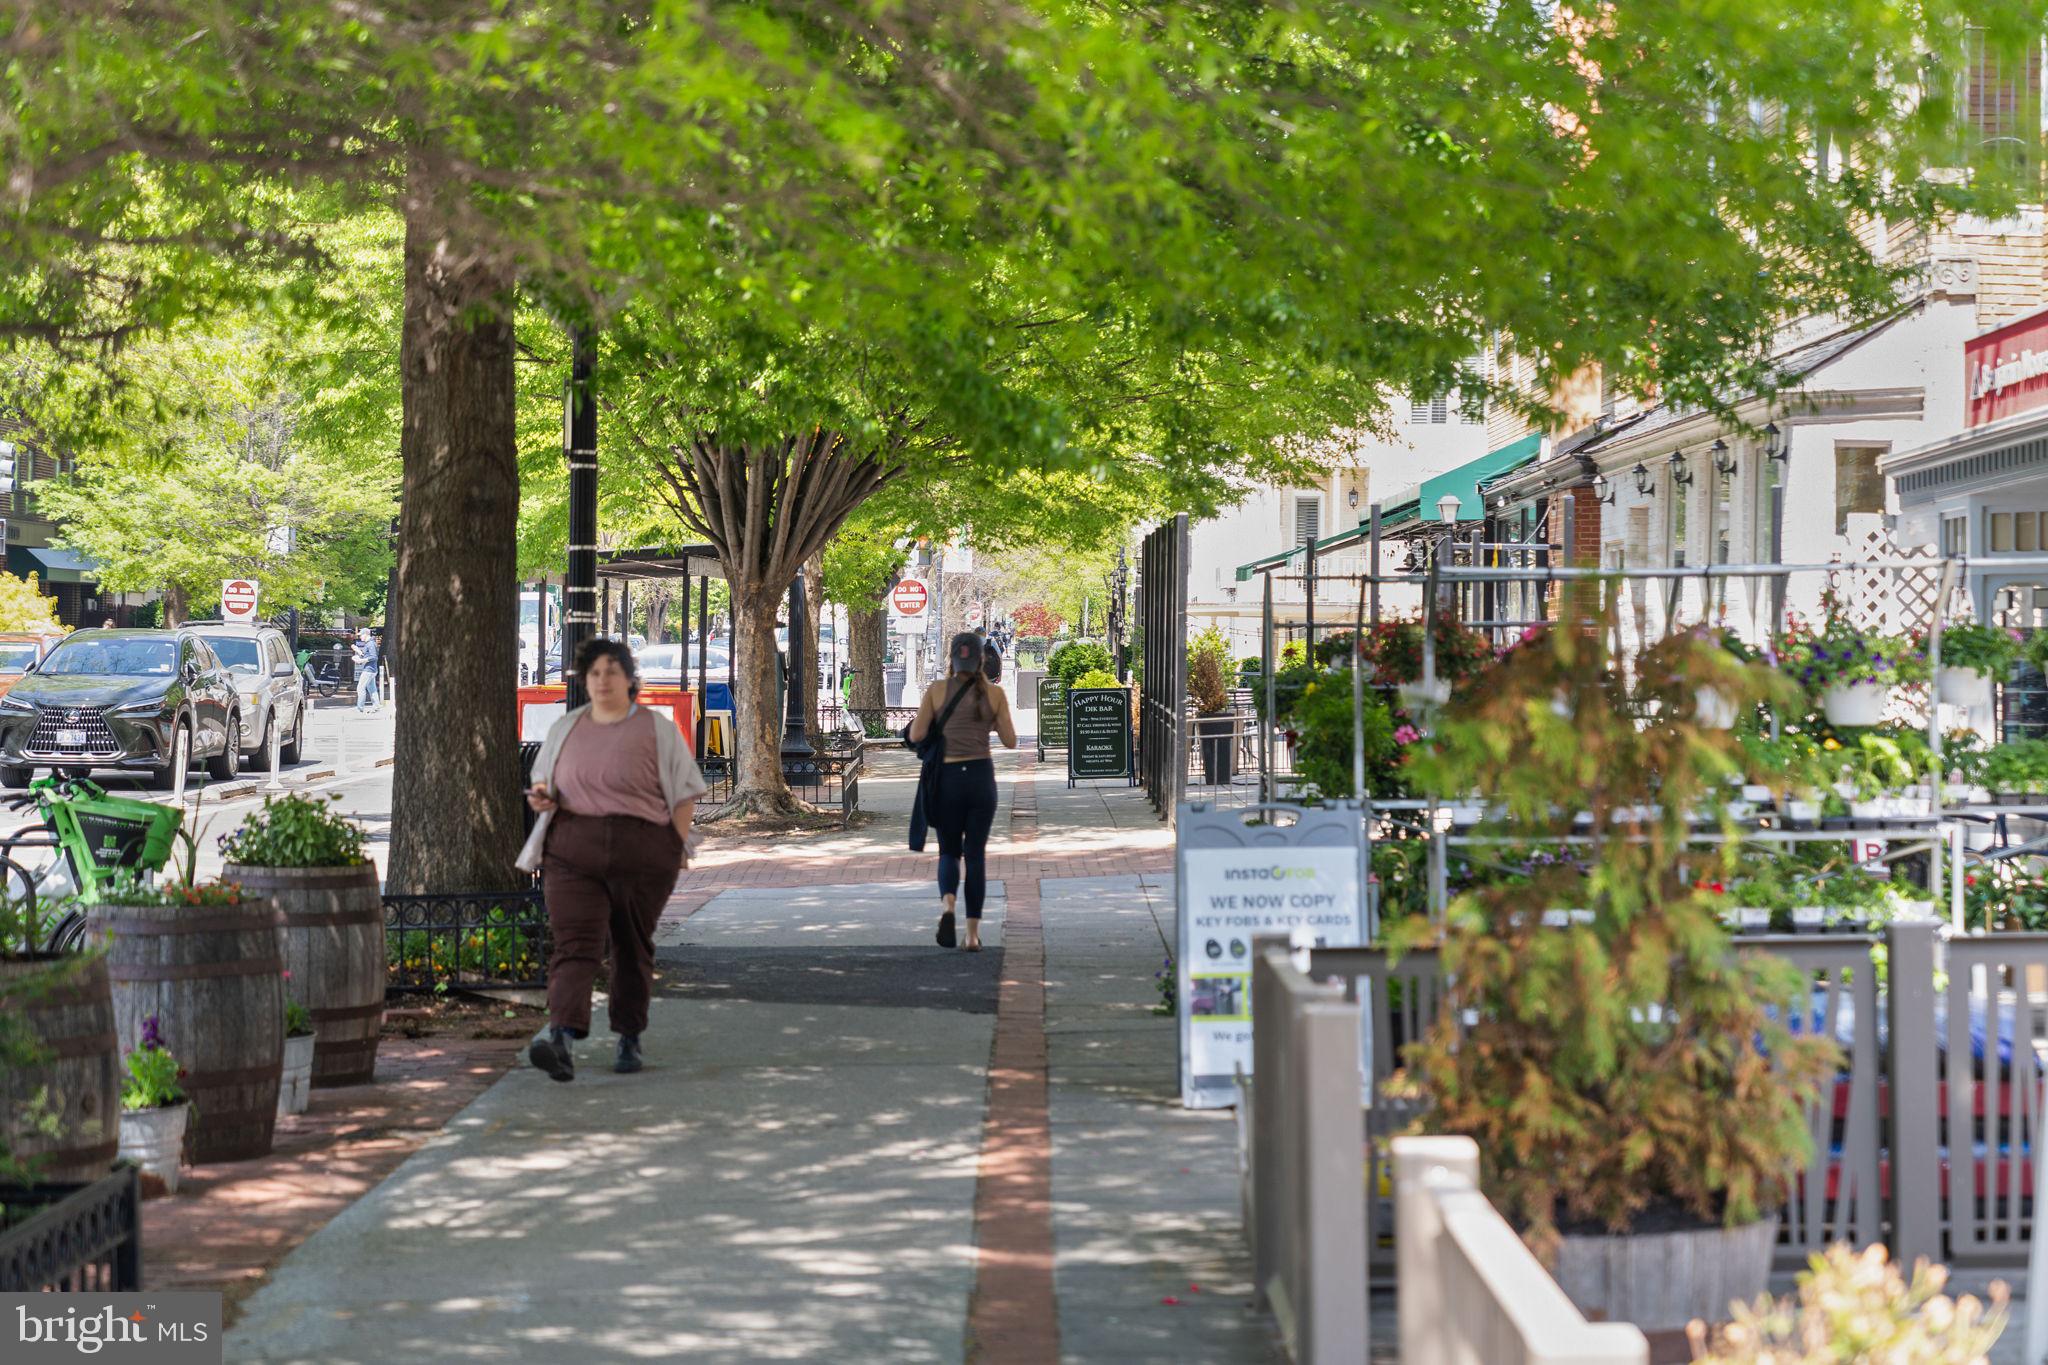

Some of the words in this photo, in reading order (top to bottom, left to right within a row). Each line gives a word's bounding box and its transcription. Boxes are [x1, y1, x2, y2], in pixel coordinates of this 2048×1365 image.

[1074, 695, 1098, 707] HAPPY
[1100, 694, 1123, 705] HOUR
[1210, 895, 1238, 909] WE
[1243, 894, 1285, 908] NOW
[1290, 893, 1335, 908] COPY
[1196, 916, 1222, 927] KEY
[1225, 915, 1259, 926] FOBS
[1263, 915, 1273, 926] &
[1277, 915, 1302, 926] KEY
[1306, 914, 1352, 926] CARDS
[1213, 1031, 1231, 1040] We
